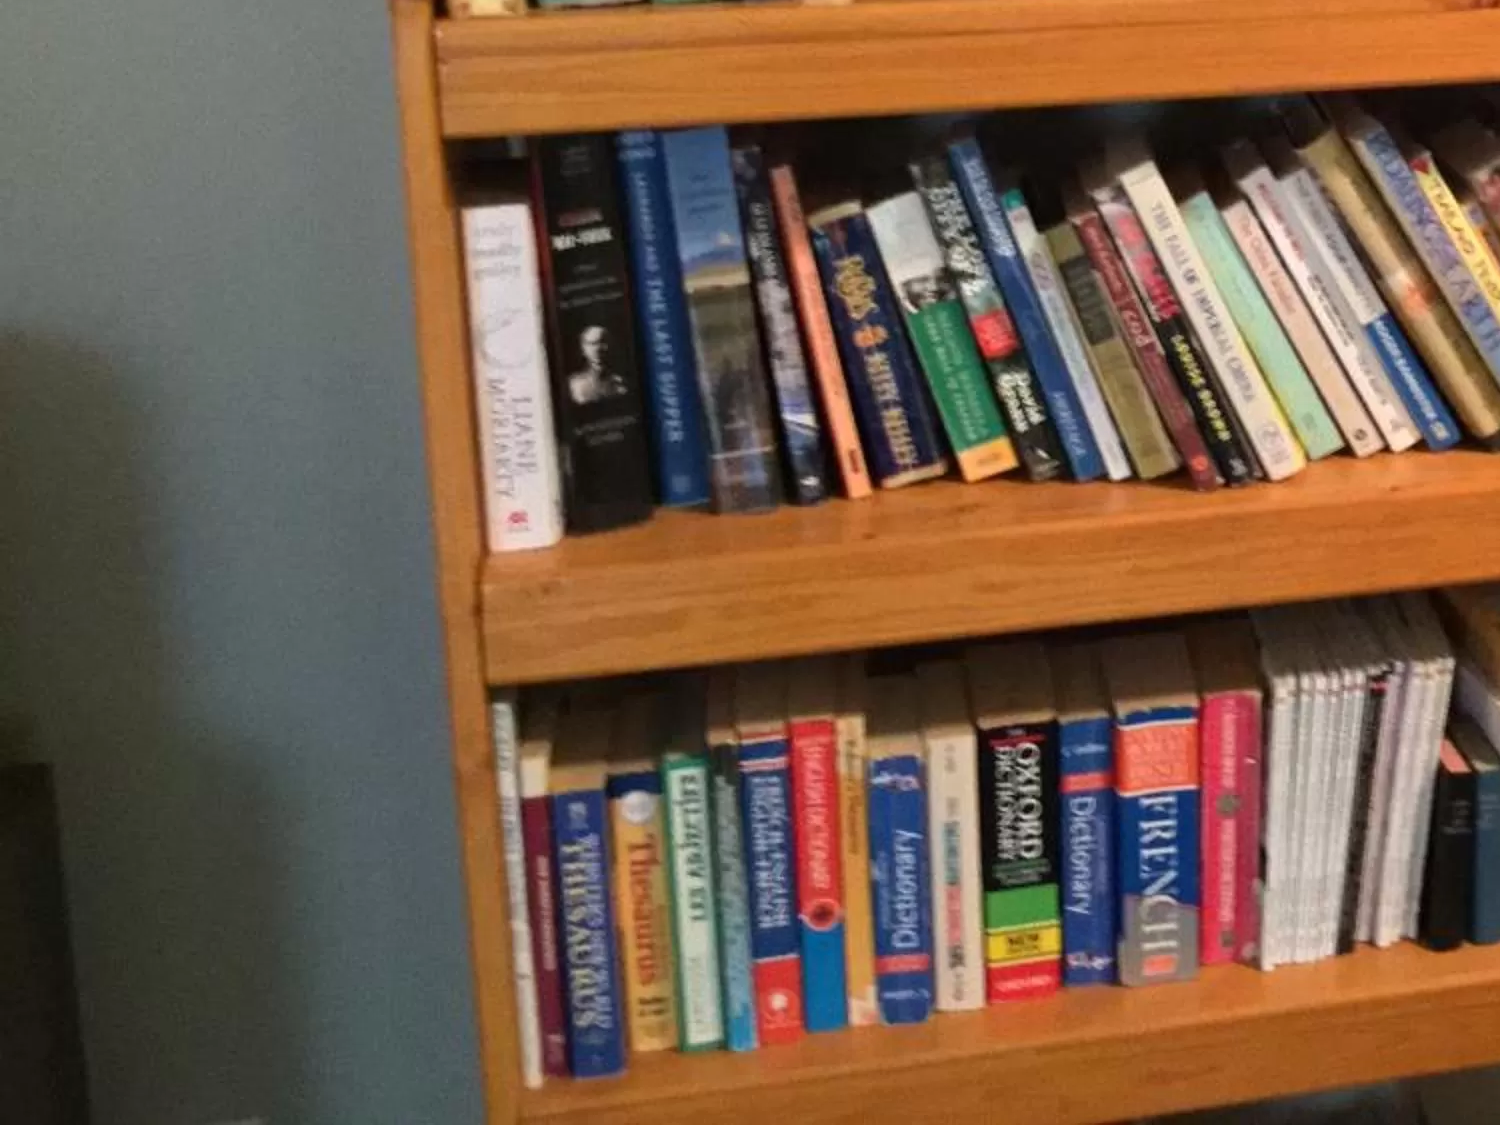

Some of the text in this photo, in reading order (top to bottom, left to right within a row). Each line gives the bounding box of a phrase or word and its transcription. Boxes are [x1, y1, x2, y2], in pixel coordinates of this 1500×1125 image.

[645, 277, 684, 443] THE LAST SUPPER
[1149, 201, 1256, 403] THE FALL OF IMPERIAL CHINA
[486, 378, 515, 500] MORIARTY
[515, 397, 538, 473] LIANE
[998, 374, 1028, 432] Grann
[1015, 370, 1045, 425] David
[1170, 335, 1231, 442] LOUISE BROWN
[992, 746, 1018, 861] DICTIONARY
[1013, 741, 1043, 859] OXFORD
[1066, 796, 1098, 916] Dictionary
[626, 833, 664, 987] Thesaurus
[891, 830, 923, 949] Dictionary
[1137, 792, 1180, 952] FRENCH
[560, 838, 598, 1028] THESAURUS
